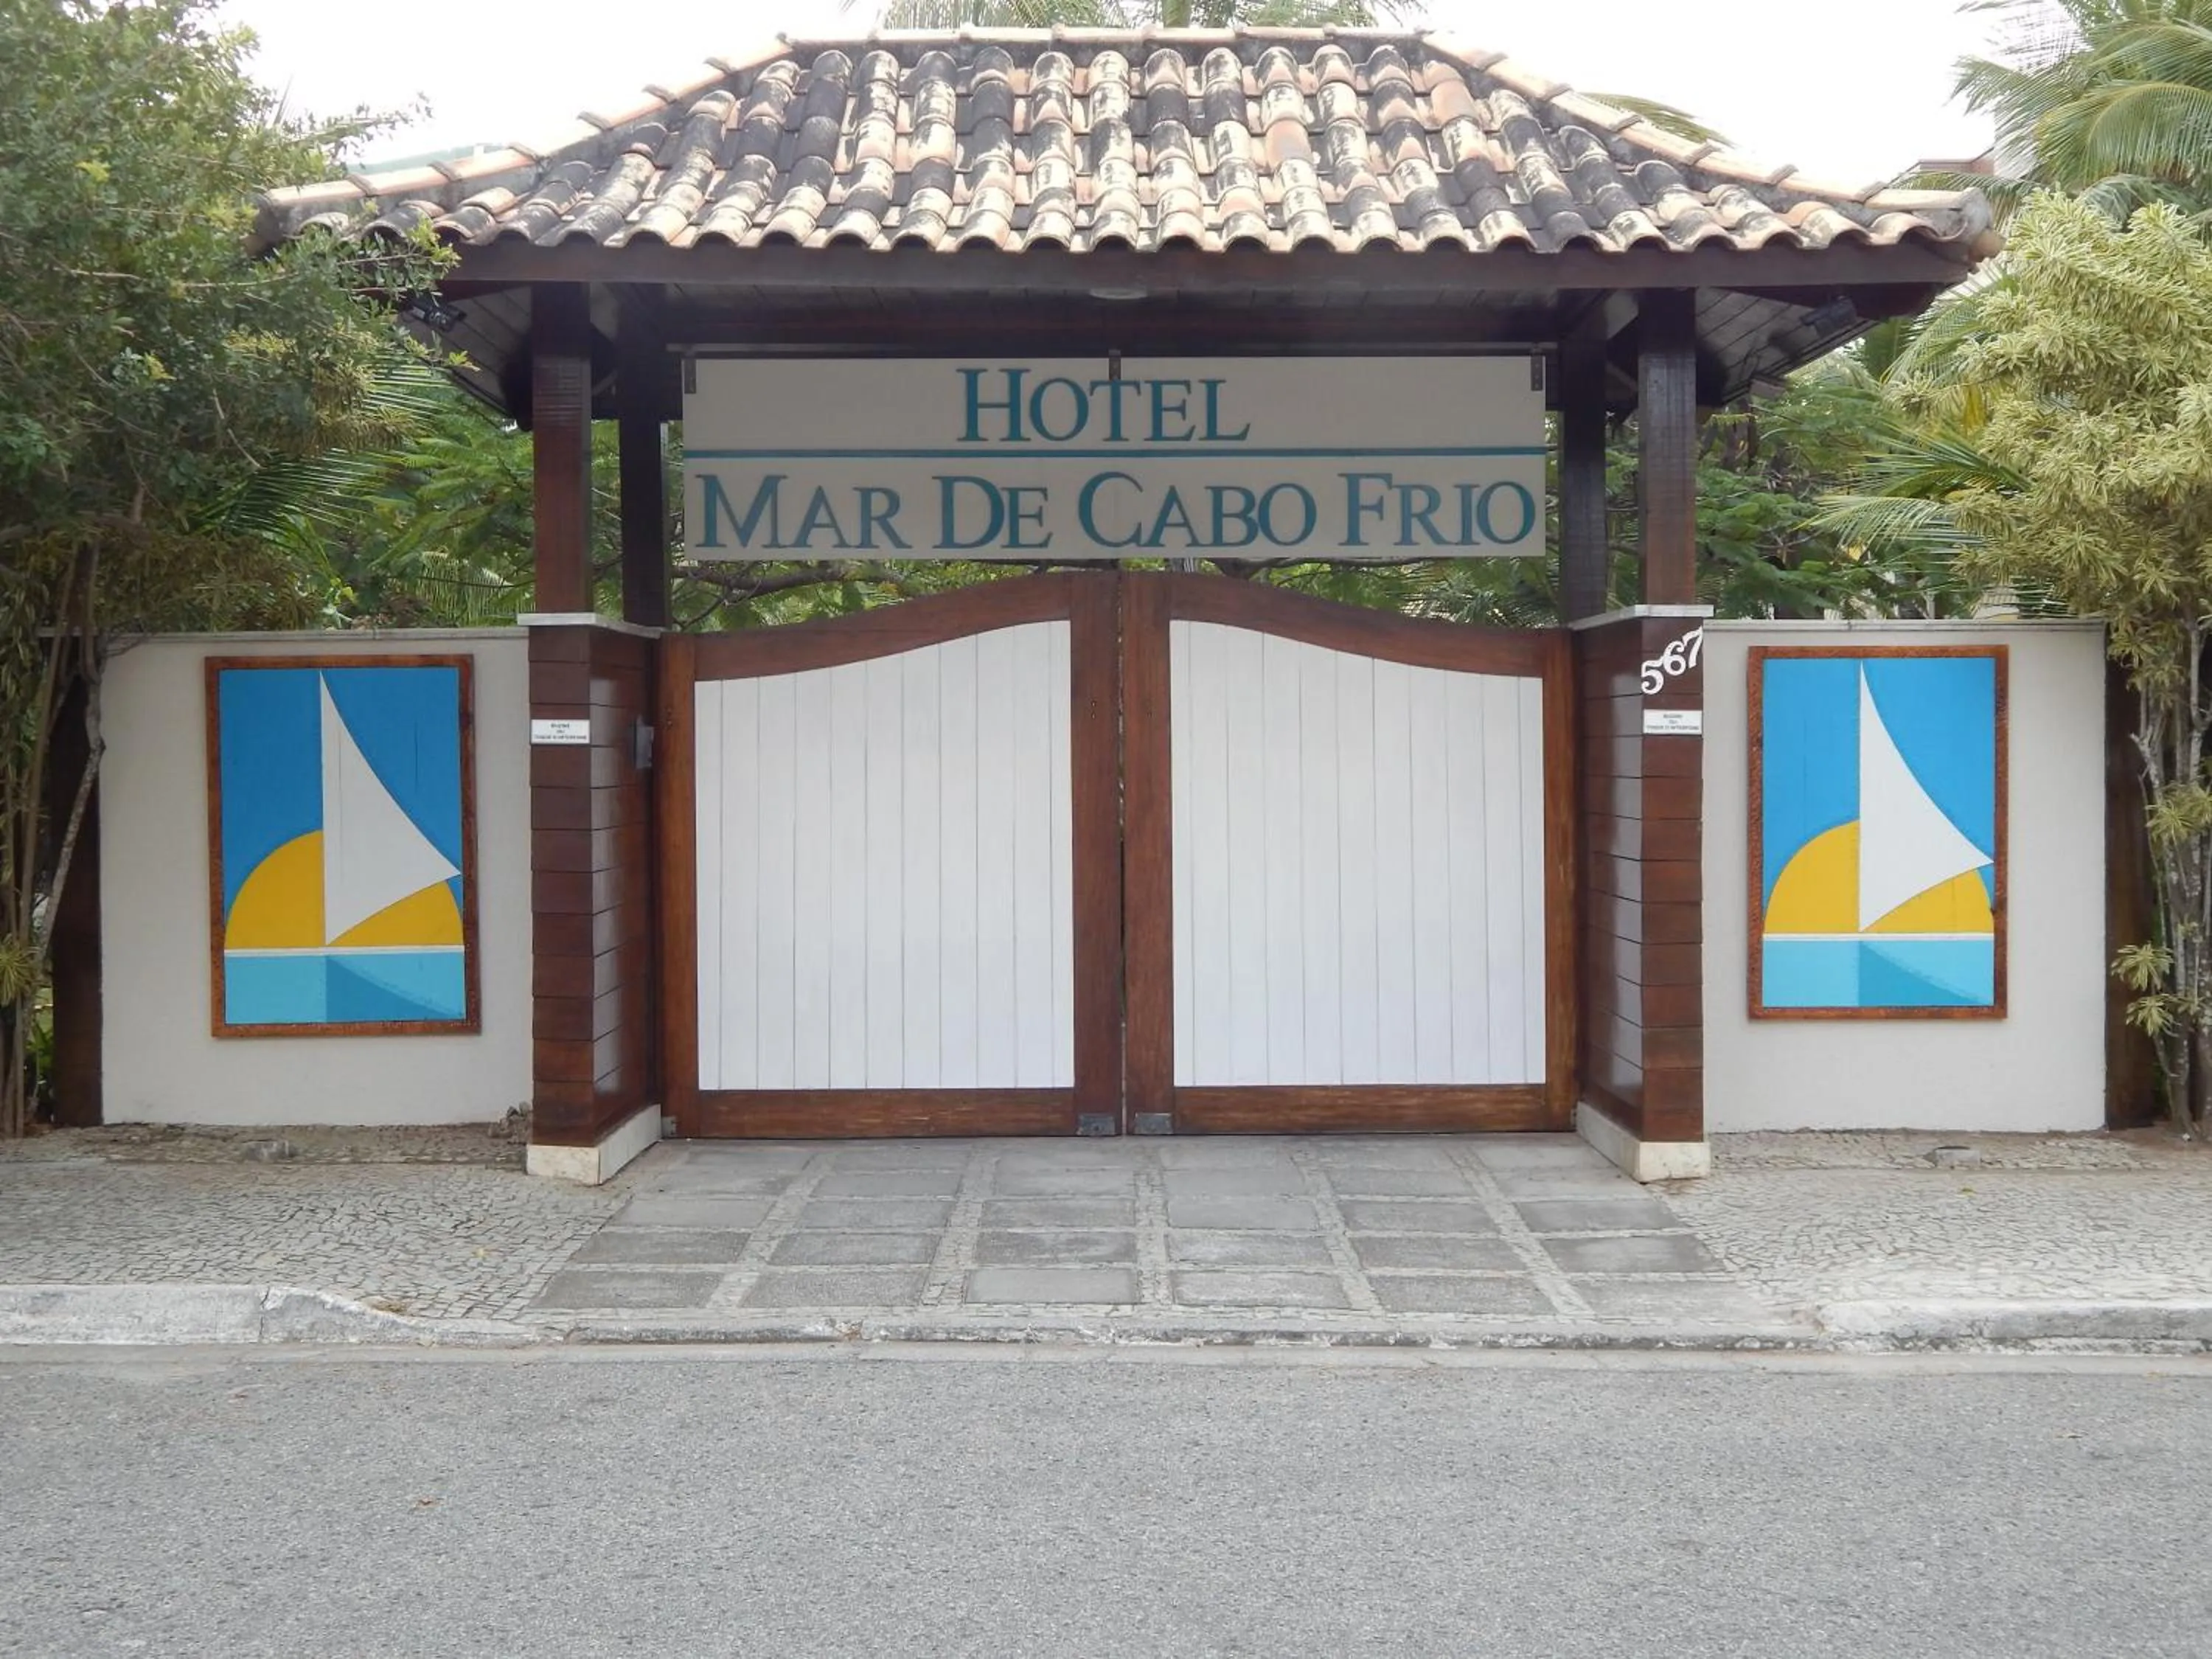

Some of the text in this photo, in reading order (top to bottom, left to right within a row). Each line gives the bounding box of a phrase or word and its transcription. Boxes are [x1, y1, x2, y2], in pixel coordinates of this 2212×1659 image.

[956, 368, 1251, 442] HOTEL
[695, 471, 1537, 550] MAR DE CABO FRIO
[1641, 626, 1703, 695] 567
